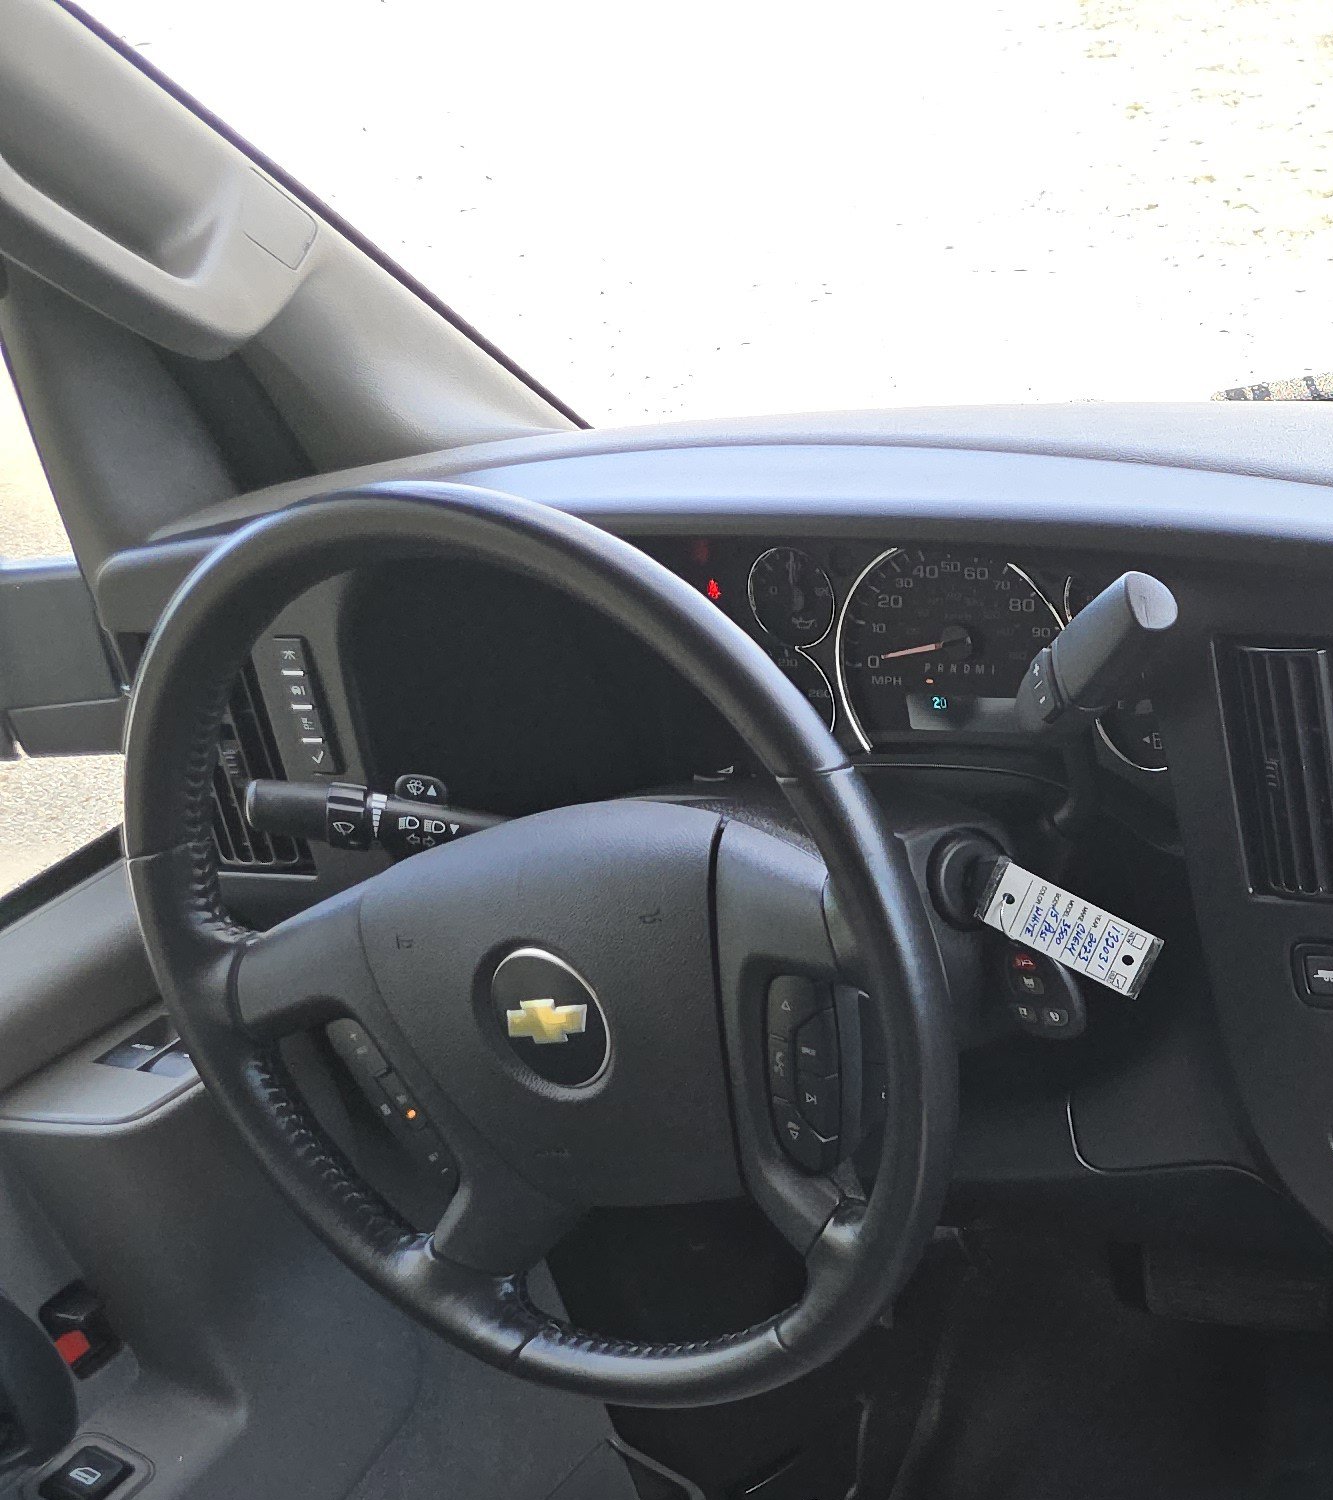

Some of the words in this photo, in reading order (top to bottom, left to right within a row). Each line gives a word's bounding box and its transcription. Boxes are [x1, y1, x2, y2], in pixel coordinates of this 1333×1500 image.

[912, 565, 939, 579] 40
[940, 561, 961, 573] 50
[963, 567, 989, 581] 60
[993, 580, 1011, 591] 70
[877, 594, 903, 609] 20
[1008, 598, 1036, 612] 80
[871, 622, 887, 634] 10
[1031, 627, 1051, 638] 90
[871, 676, 902, 686] MPH
[931, 695, 948, 710] 20
[1035, 885, 1048, 905] COLOR
[1062, 899, 1075, 917] MODEL
[1078, 906, 1088, 922] MAKE
[1092, 914, 1102, 929] YEAR
[1055, 919, 1072, 945] 3500
[1078, 933, 1097, 962] 2023
